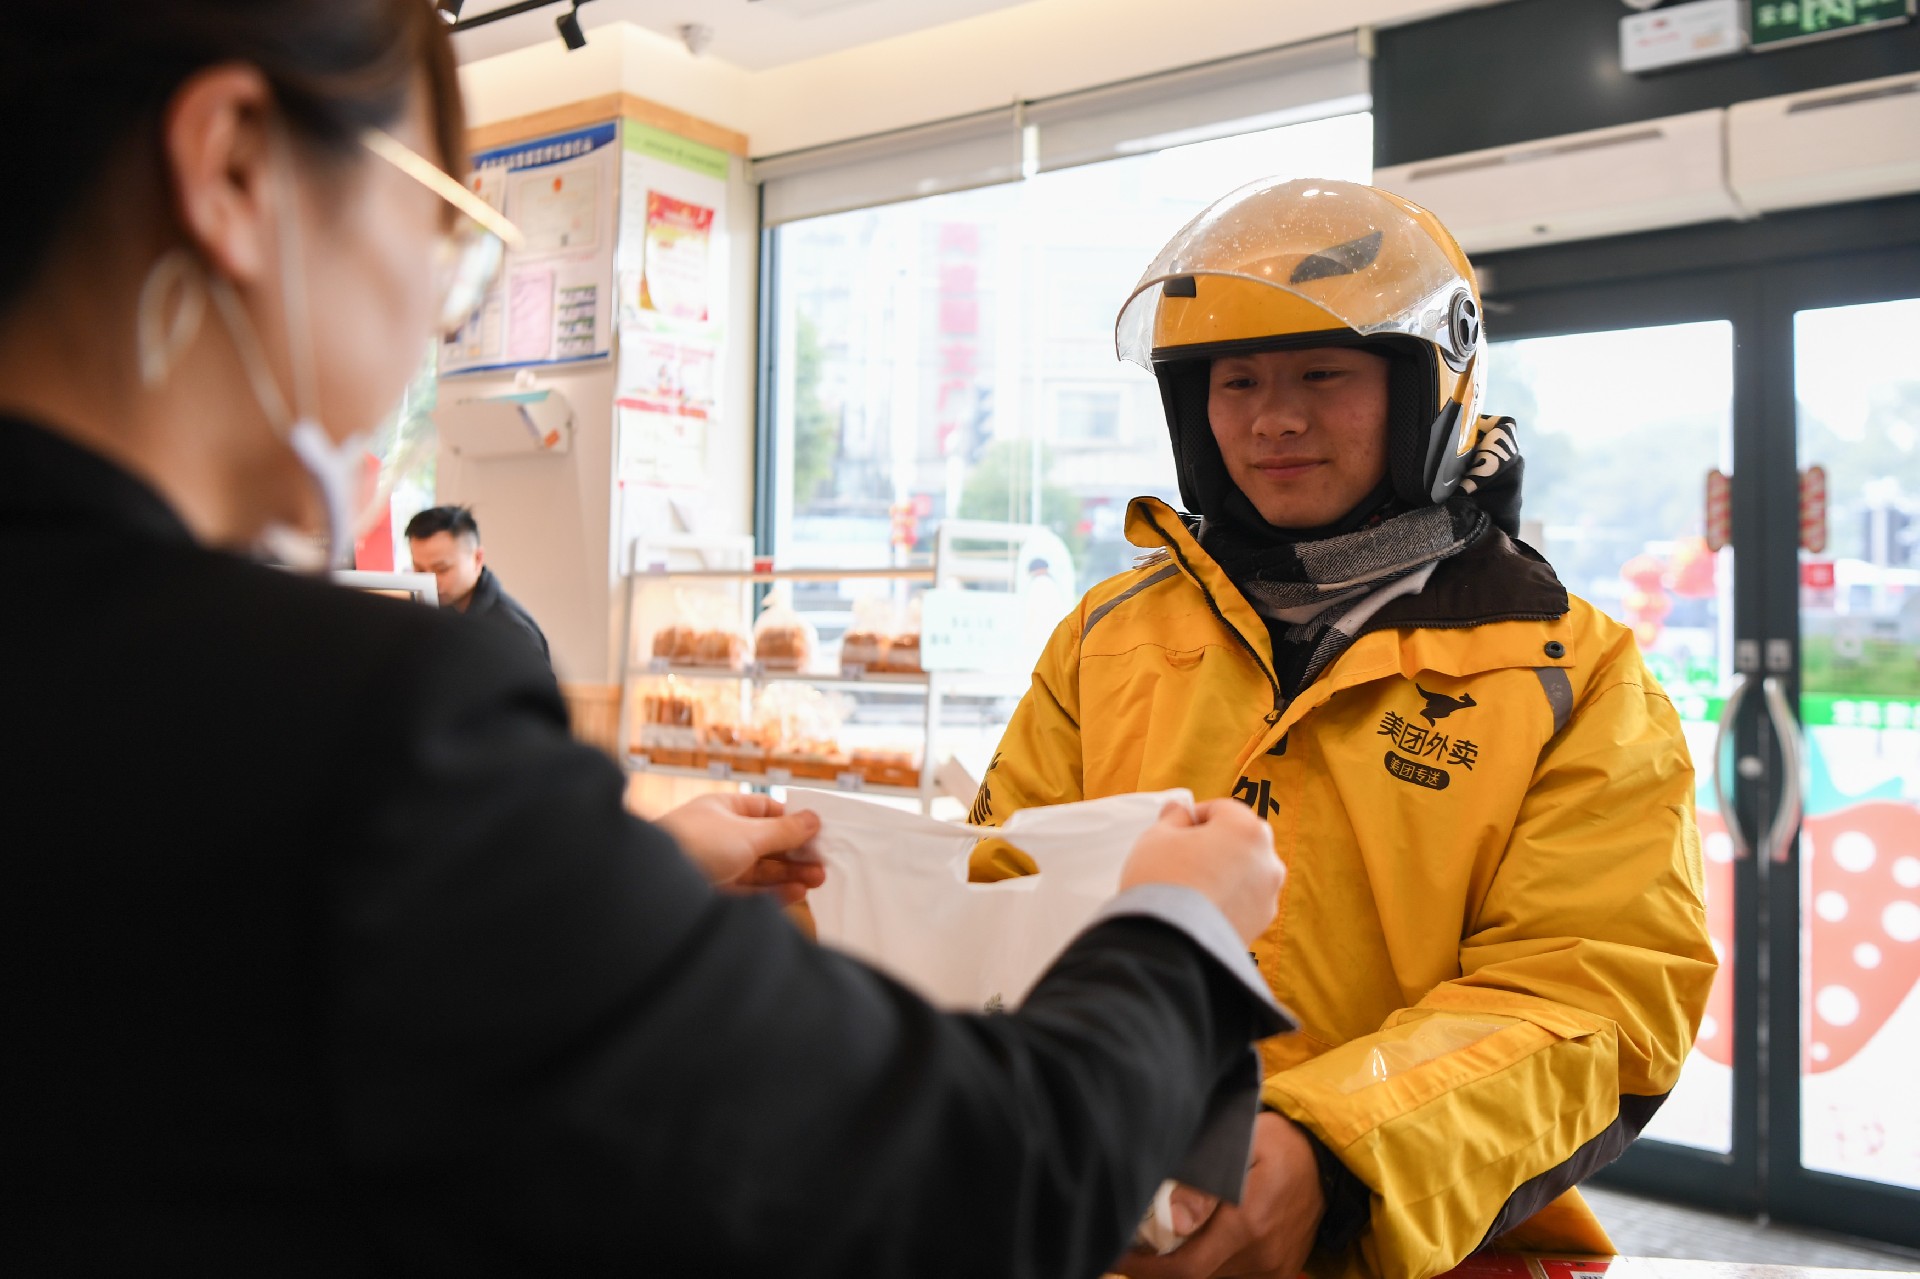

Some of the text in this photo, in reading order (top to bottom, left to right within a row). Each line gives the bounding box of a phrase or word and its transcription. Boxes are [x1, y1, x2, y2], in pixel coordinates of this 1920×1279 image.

[1377, 711, 1478, 771] 美团外卖
[1389, 757, 1441, 787] 美团专送
